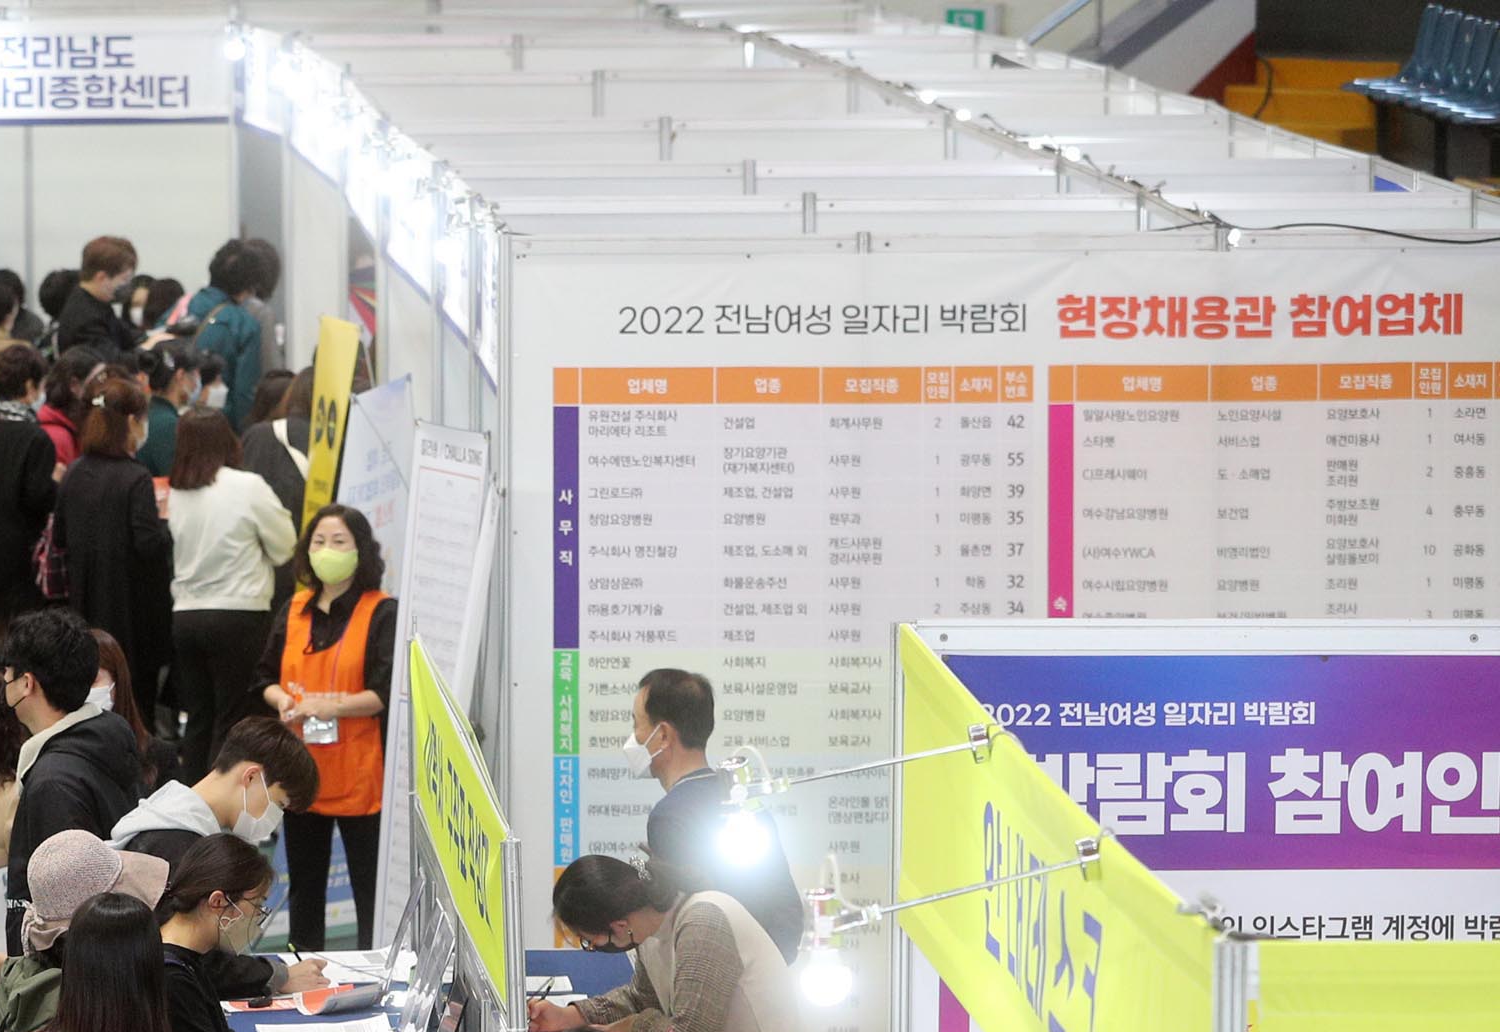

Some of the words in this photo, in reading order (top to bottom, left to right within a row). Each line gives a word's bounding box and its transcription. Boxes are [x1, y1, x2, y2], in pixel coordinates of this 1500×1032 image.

[619, 306, 704, 335] 2022
[714, 304, 833, 335] 전남여성
[842, 304, 929, 334] 일자리
[940, 303, 1028, 334] 박람회
[1057, 294, 1276, 340] 현장채용관
[1290, 292, 1463, 337] 참여업체
[634, 409, 677, 423] 주식회사
[1427, 408, 1432, 418] 1
[723, 417, 755, 429] 건설업
[934, 417, 941, 429] 2
[1007, 414, 1025, 429] 42
[635, 425, 667, 437] 리조트
[1217, 434, 1260, 448] 서비스업
[1427, 434, 1432, 445] 1
[829, 454, 861, 467] 사무원
[1008, 453, 1024, 466] 55
[1426, 466, 1433, 477] 2
[761, 486, 794, 499] 건설업
[829, 486, 861, 499] 사무원
[1007, 484, 1024, 498] 39
[723, 512, 766, 525] 요양병원
[829, 512, 861, 525] 원무과
[1007, 511, 1024, 525] 35
[558, 488, 573, 567] 사무직
[588, 545, 631, 558] 주식회사
[1007, 543, 1024, 557] 37
[1423, 544, 1436, 556] 10
[829, 576, 861, 588] 사무원
[1007, 575, 1024, 588] 32
[829, 603, 861, 616] 사무원
[1007, 601, 1024, 615] 34
[588, 629, 631, 643] 주식회사
[723, 629, 755, 642] 제조업
[829, 629, 861, 642] 사무원
[722, 656, 766, 668] 사회복지
[828, 656, 882, 668] 사회복지사
[828, 682, 871, 695] 보육교사
[722, 709, 765, 722] 요양병원
[828, 709, 882, 721] 사회복지사
[984, 703, 1052, 727] 2022
[1058, 702, 1156, 727] 전남여성
[1163, 702, 1236, 726] 일자리
[1243, 701, 1316, 726] 박람회
[723, 736, 746, 747] 교육
[751, 735, 790, 747] 서비스업
[828, 735, 871, 747] 보육교사
[828, 841, 860, 853] 사무원
[1252, 915, 1373, 941] 인스타그램
[1382, 915, 1455, 940] 계정에
